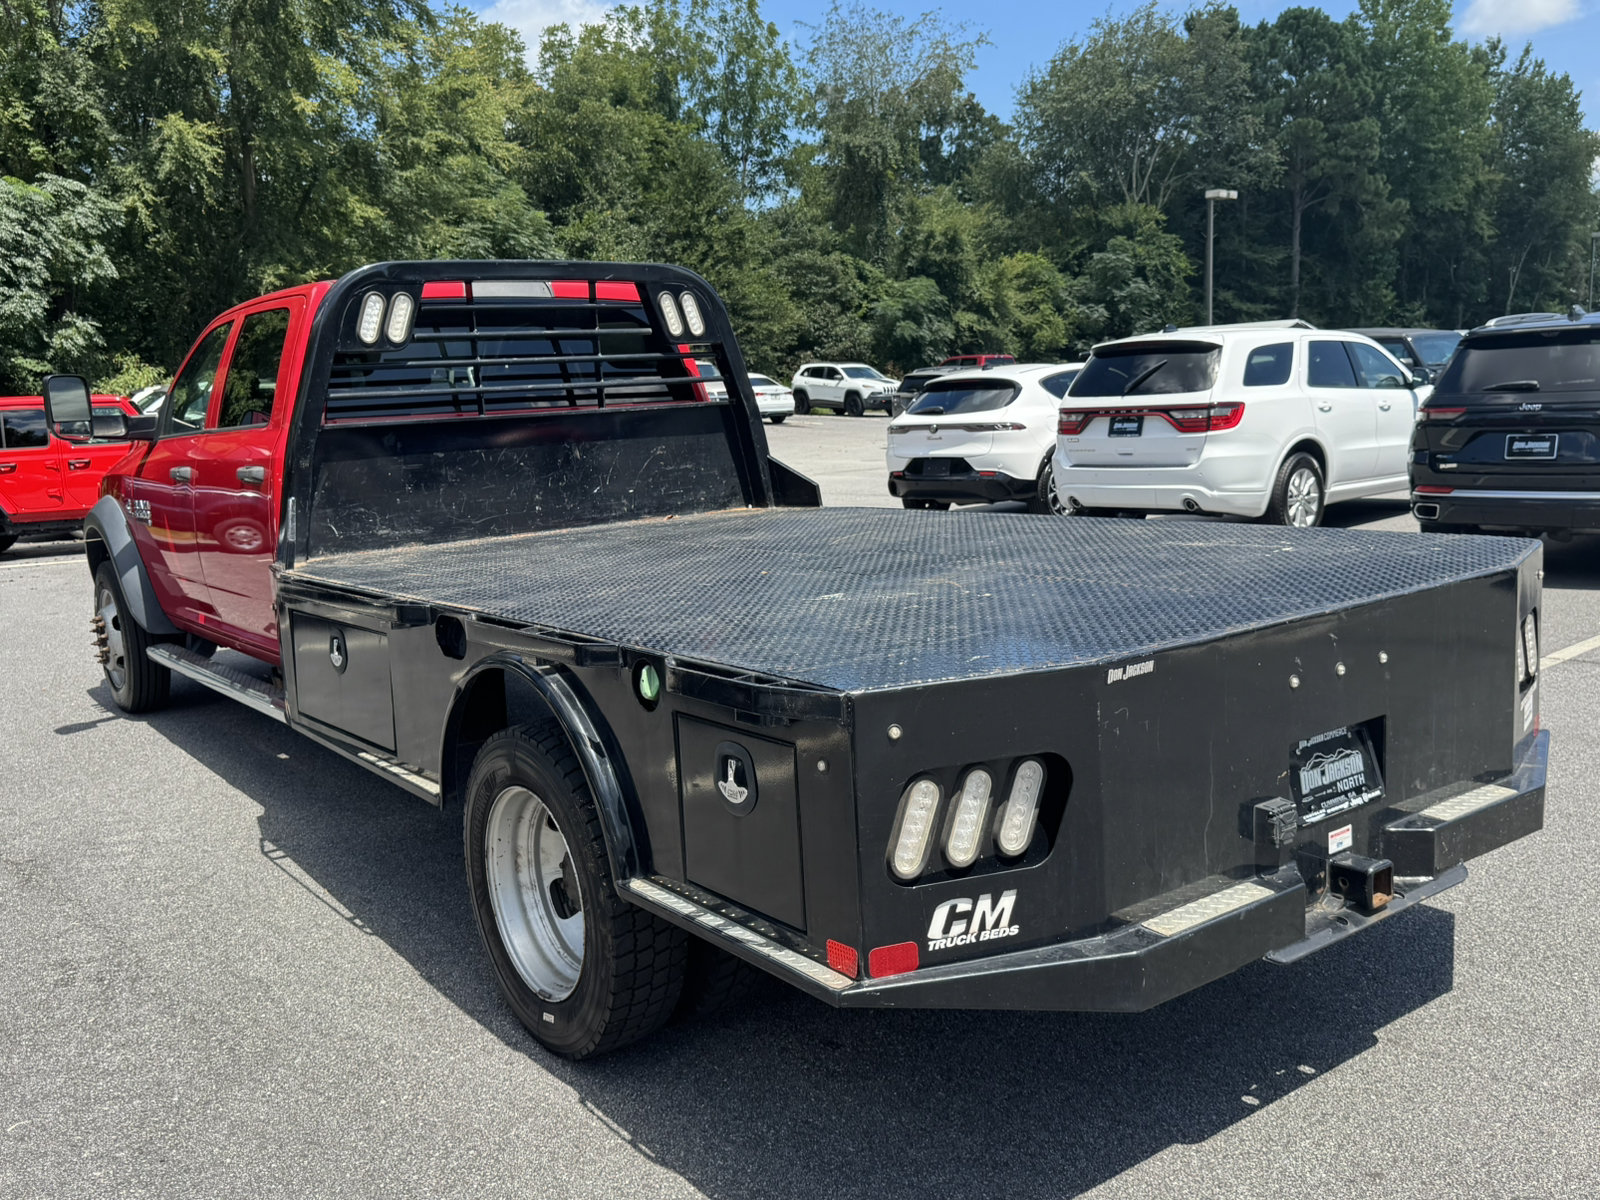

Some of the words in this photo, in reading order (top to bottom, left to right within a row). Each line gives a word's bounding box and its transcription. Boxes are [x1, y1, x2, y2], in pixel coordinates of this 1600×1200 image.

[1519, 402, 1542, 411] Jeep
[1107, 668, 1123, 684] DON
[1123, 660, 1154, 680] JACKSON
[1300, 768, 1322, 796] DON
[1322, 755, 1364, 785] JACKSON
[1336, 773, 1365, 792] NORTH
[927, 888, 1018, 939] CM
[928, 932, 978, 951] TRUCK
[980, 925, 1020, 941] BEDS
